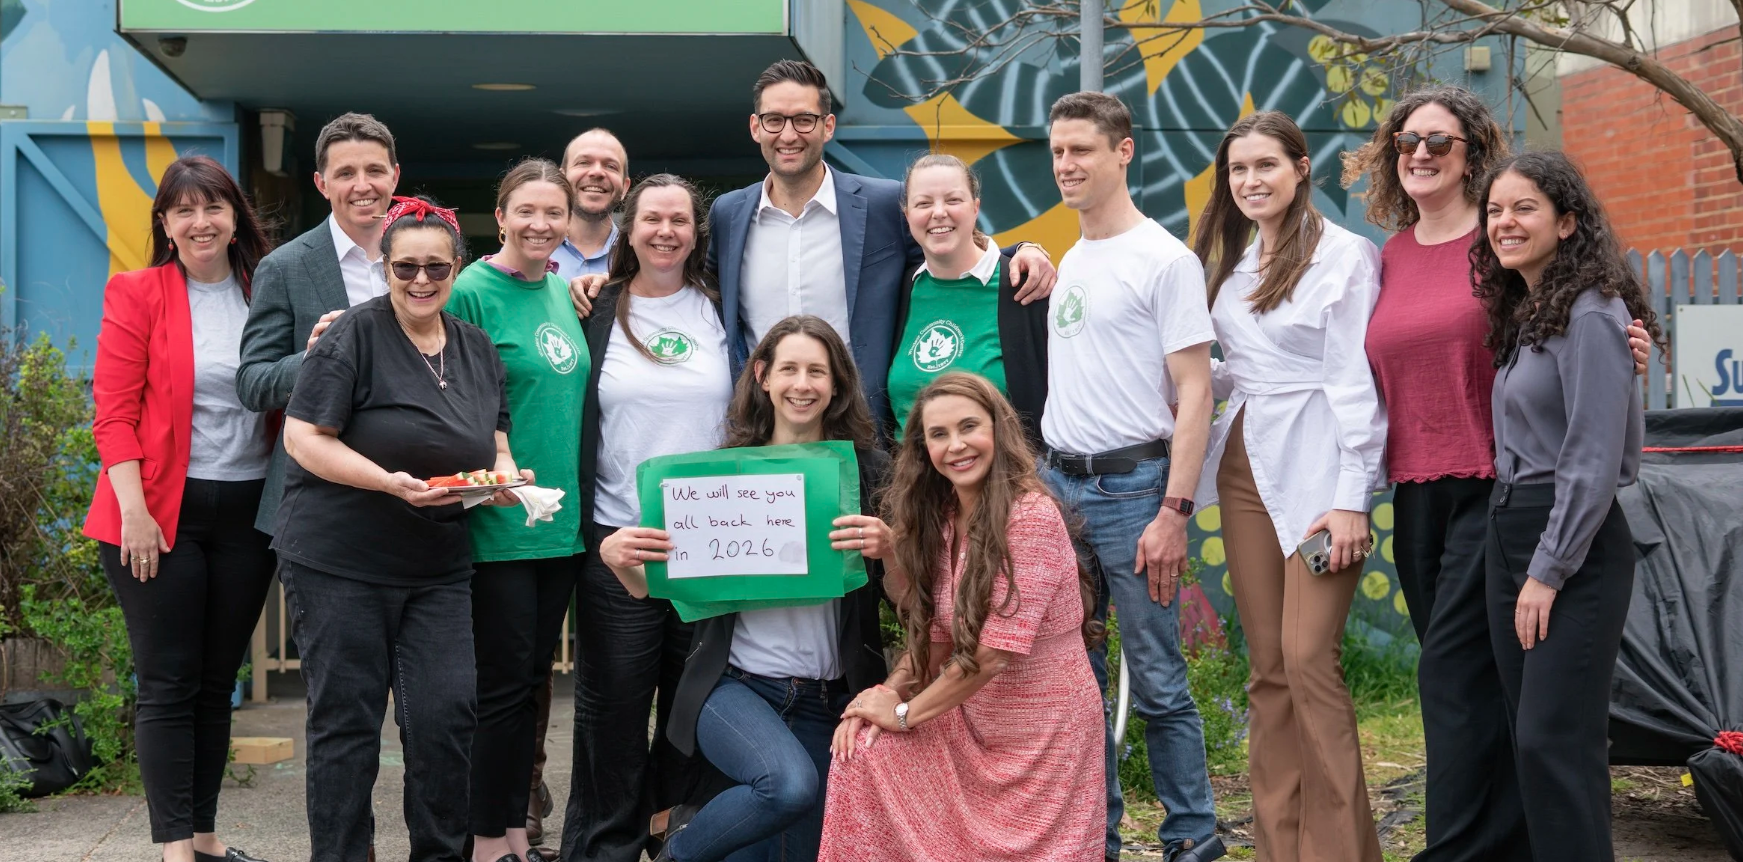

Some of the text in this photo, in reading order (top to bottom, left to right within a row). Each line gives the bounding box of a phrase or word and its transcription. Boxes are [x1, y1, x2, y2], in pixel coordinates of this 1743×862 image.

[672, 483, 796, 504] We will see you
[673, 513, 795, 529] all back here
[675, 538, 774, 561] in 2026
